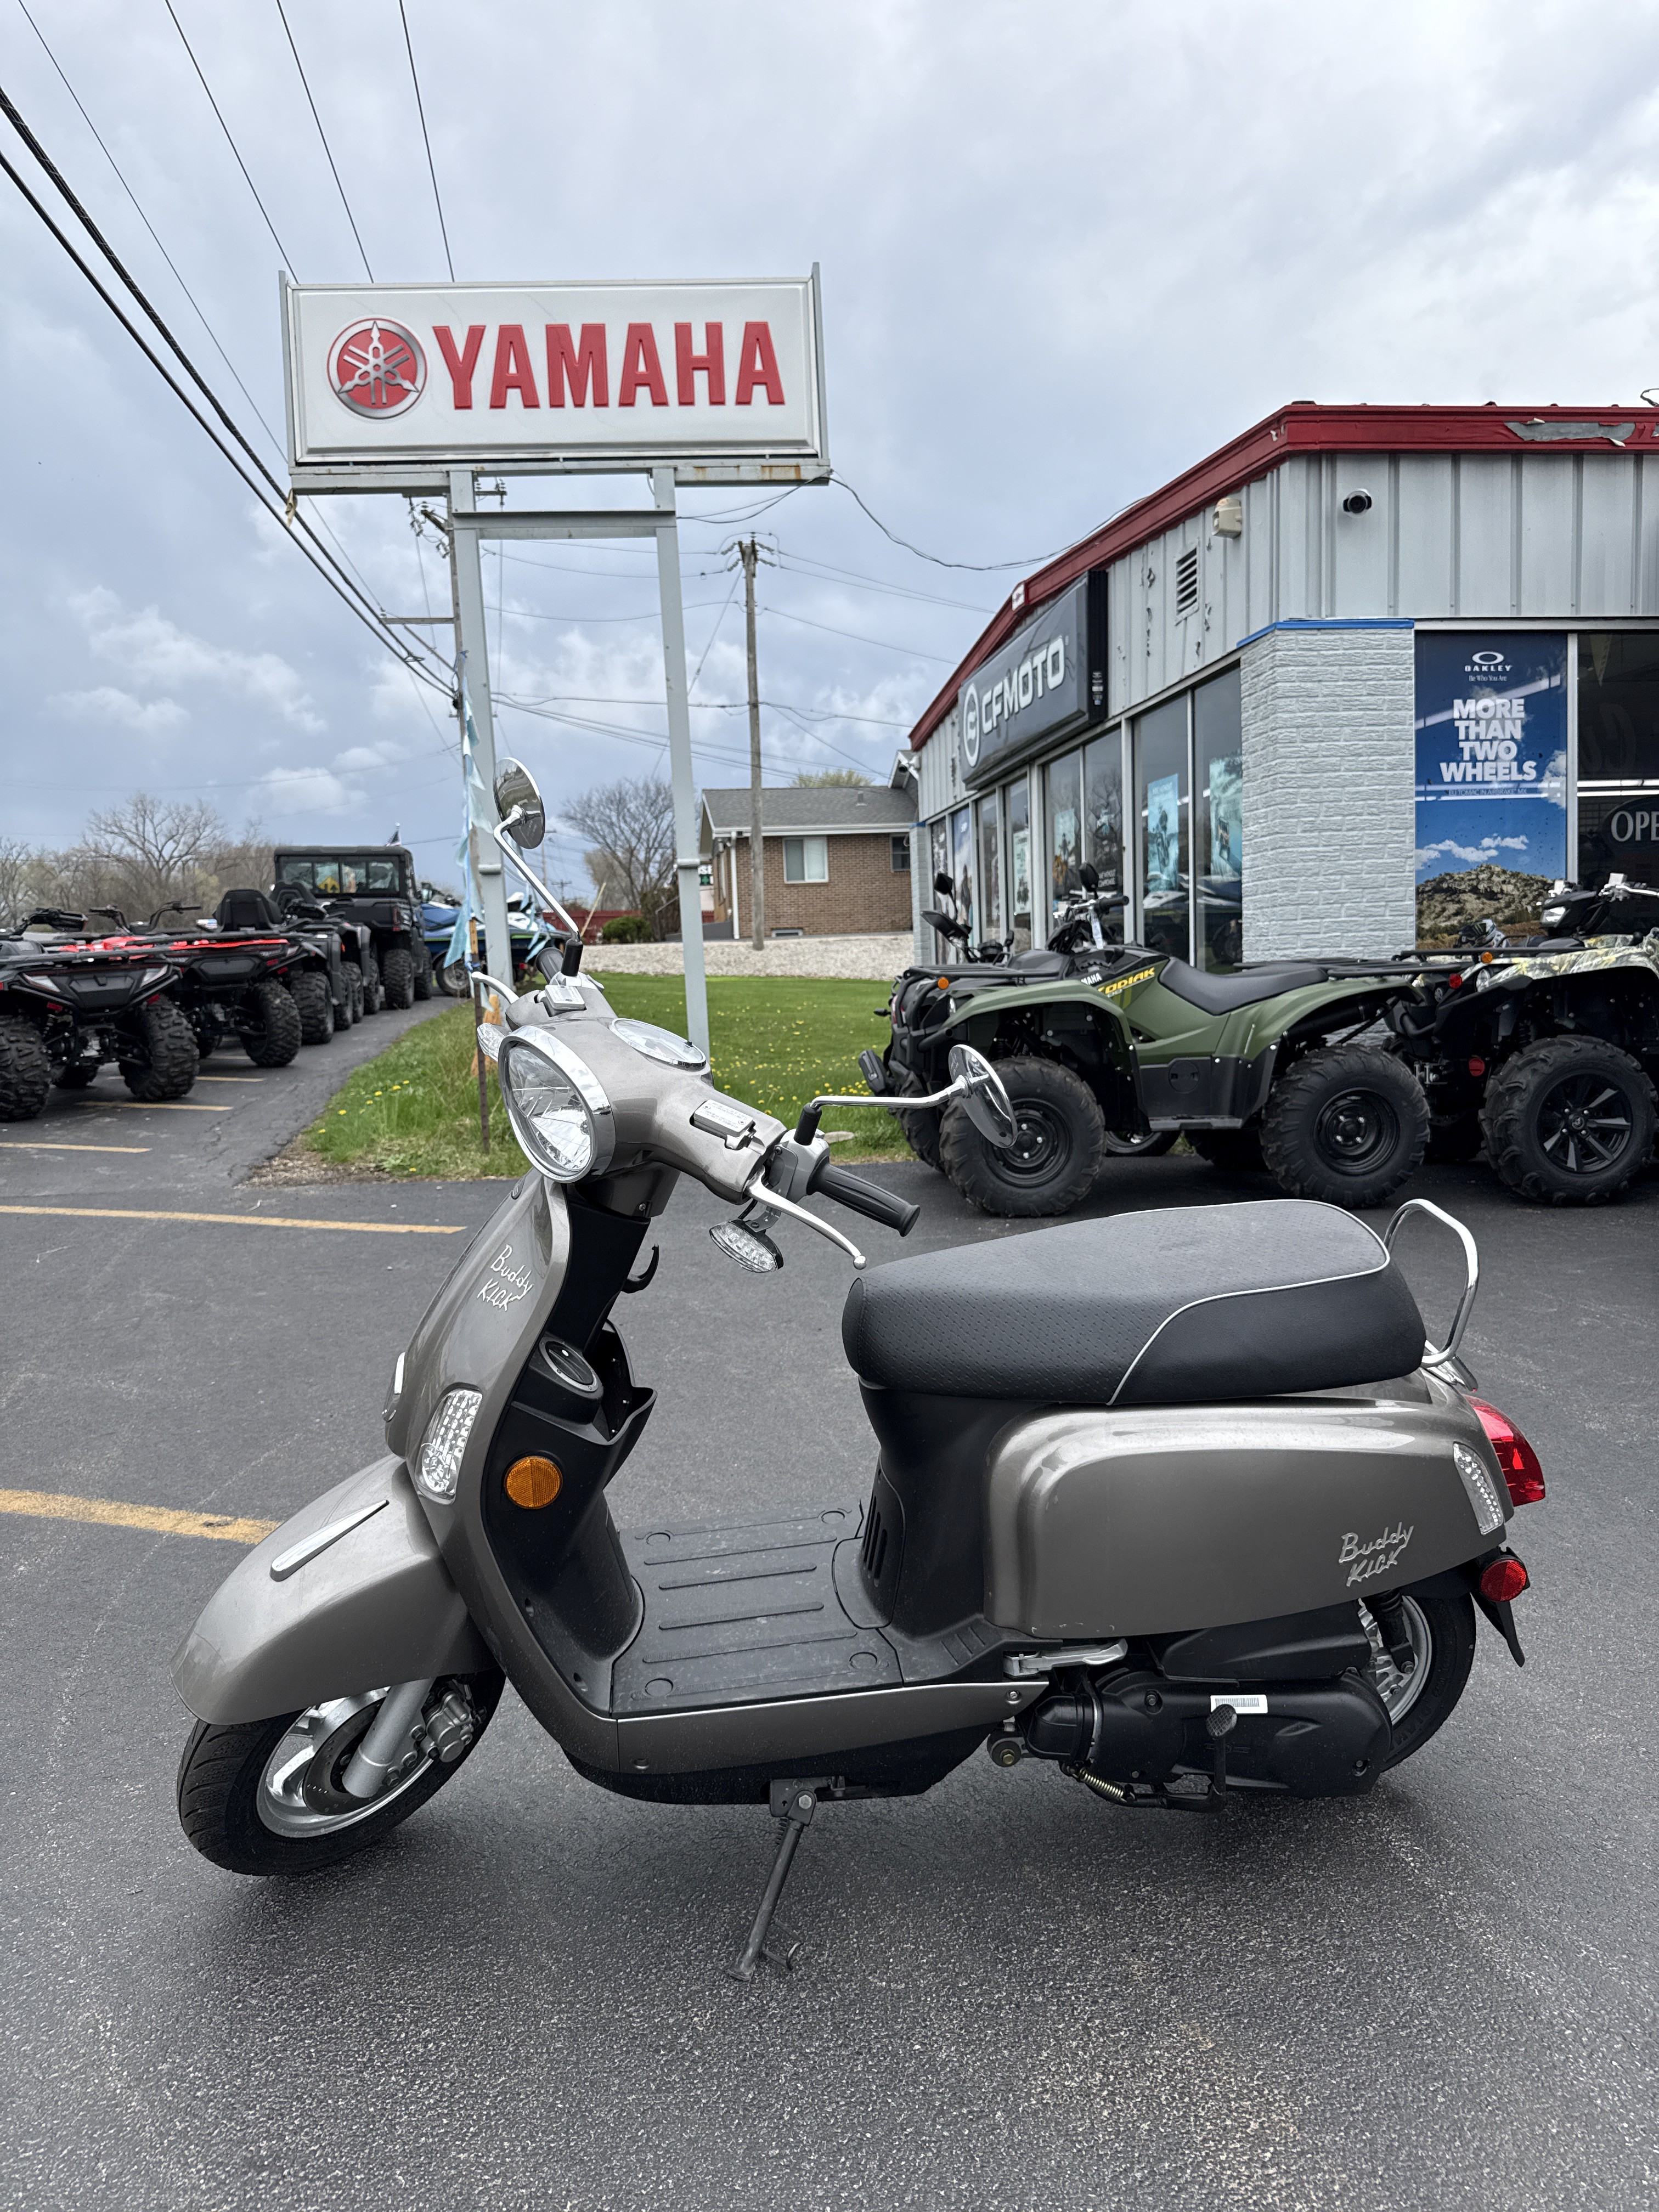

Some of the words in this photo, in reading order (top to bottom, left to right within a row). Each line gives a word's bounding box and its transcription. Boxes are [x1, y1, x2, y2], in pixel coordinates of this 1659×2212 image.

[432, 321, 785, 409] YAMAHA
[981, 635, 1065, 735] CFMOTO
[1453, 698, 1525, 719] MORE
[1454, 720, 1521, 740] THAN
[1459, 741, 1517, 761] TWO
[1440, 760, 1537, 782] WHEELS
[1611, 810, 1659, 842] OPE
[1081, 972, 1102, 985] MAHA
[490, 1244, 534, 1300] Buddy
[1339, 1522, 1414, 1563] Buddy
